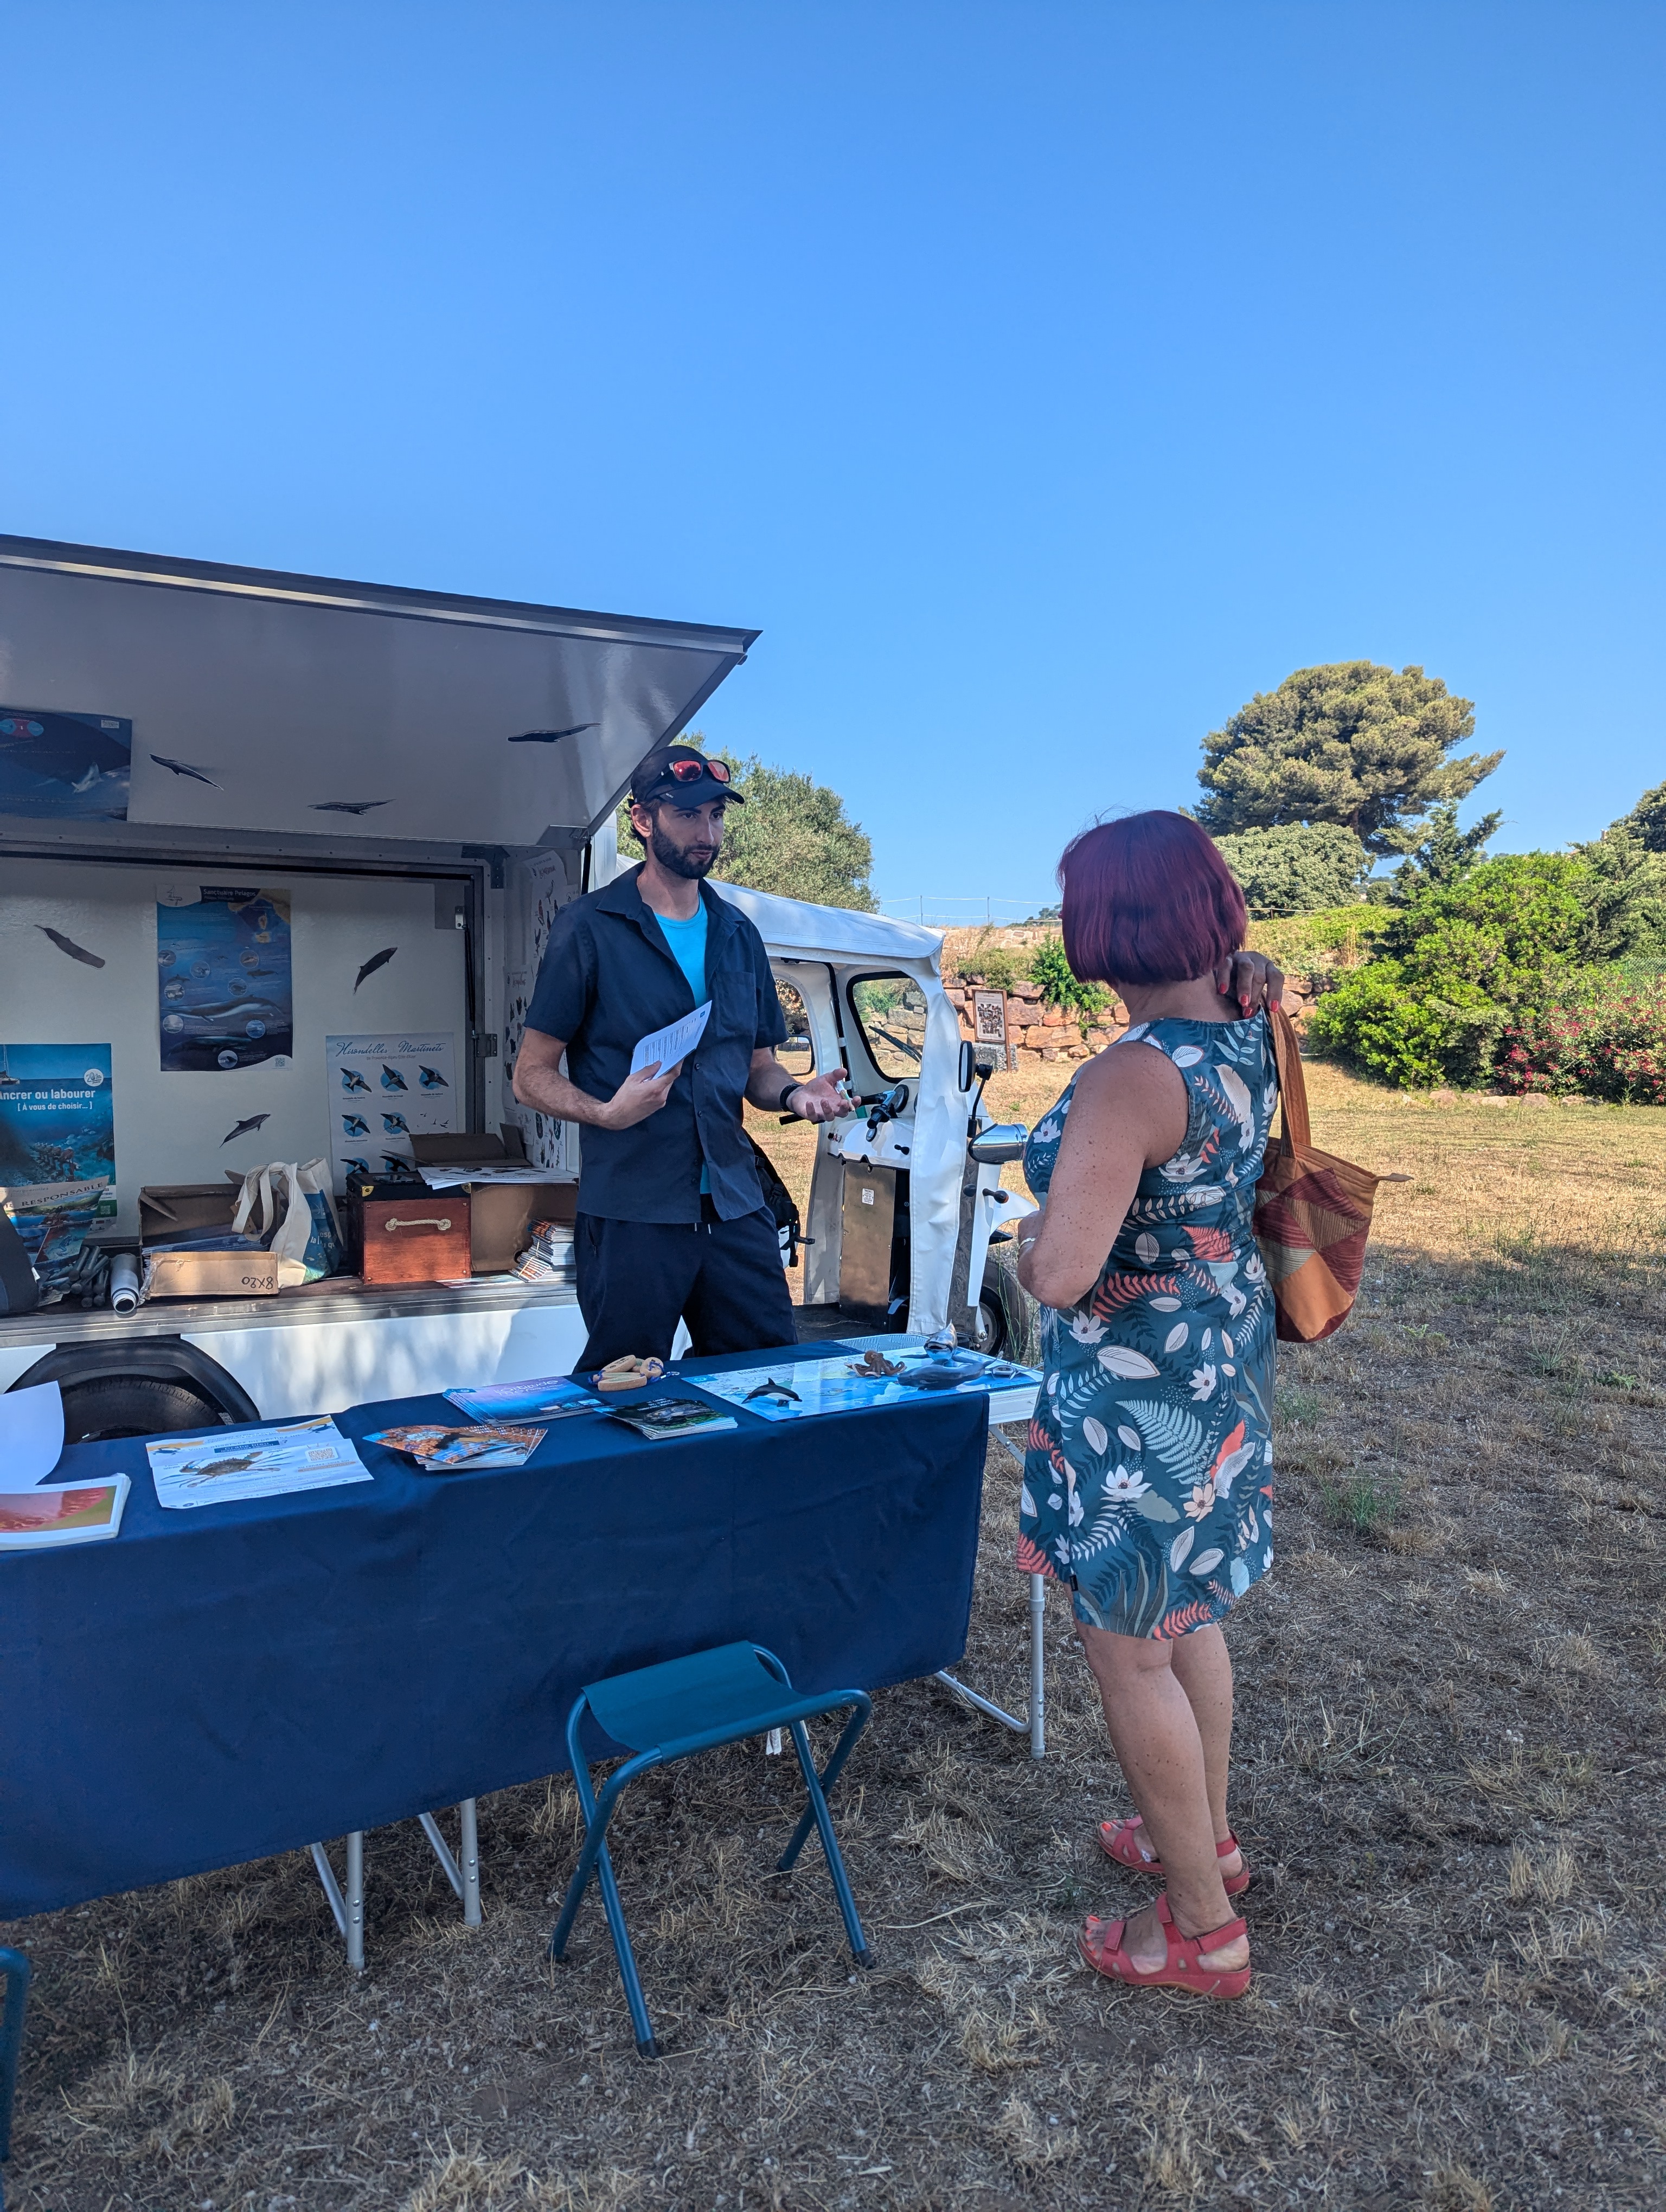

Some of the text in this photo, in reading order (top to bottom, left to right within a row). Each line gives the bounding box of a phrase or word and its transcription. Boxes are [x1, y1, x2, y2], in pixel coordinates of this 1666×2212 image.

[336, 1041, 387, 1057] Hirondelles
[398, 1040, 446, 1053] Martinets
[51, 1089, 96, 1099] labourer
[22, 1102, 27, 1110] À
[22, 1182, 103, 1206] RESPONSABLE
